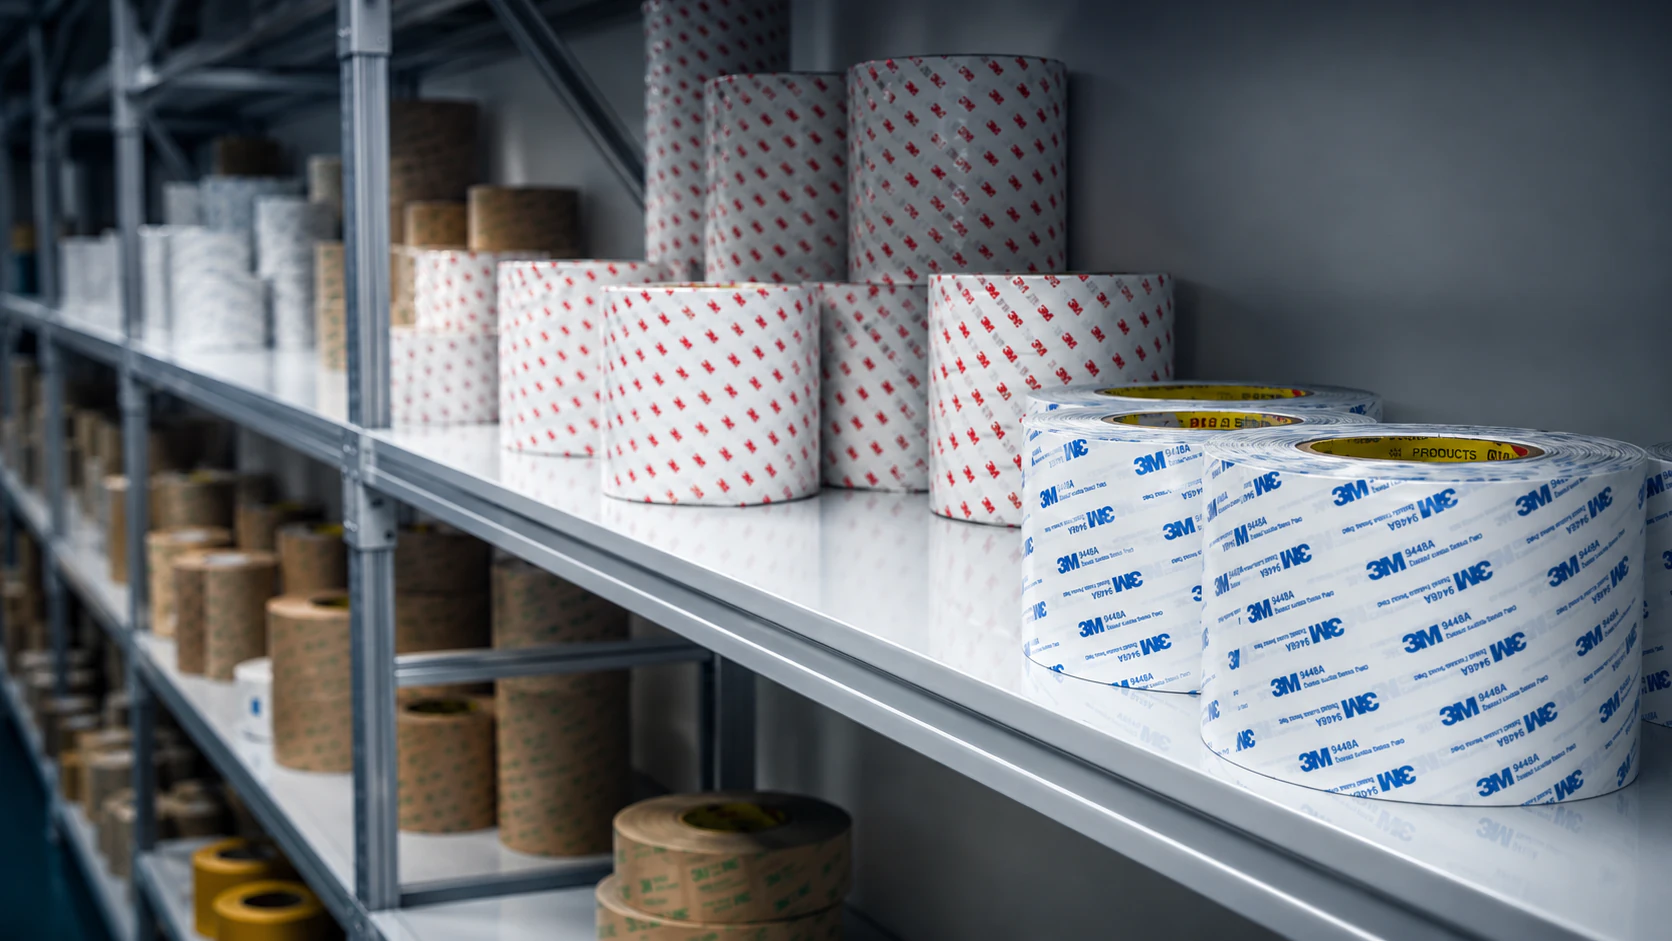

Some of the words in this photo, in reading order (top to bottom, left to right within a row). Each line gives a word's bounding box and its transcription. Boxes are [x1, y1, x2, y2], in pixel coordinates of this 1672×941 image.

[985, 282, 1000, 299] 3M
[980, 316, 995, 333] 3M
[1037, 304, 1054, 321] 3M
[1002, 345, 1018, 363] 3M
[1031, 339, 1047, 356] 3M
[1062, 332, 1077, 349] 3M
[976, 351, 991, 368] 3M
[991, 421, 1005, 440] 3M
[1133, 451, 1166, 477] 3M
[1412, 447, 1477, 461] PRODUCTS
[1039, 485, 1059, 509] 3M
[1252, 471, 1283, 497] 3M
[1332, 479, 1369, 507] 3M
[1416, 486, 1459, 520] 3M
[1516, 483, 1553, 517] 3M
[1587, 486, 1614, 519] 3M
[1085, 505, 1116, 529] 3M
[1162, 516, 1197, 541] 3M
[1056, 552, 1081, 575] 3M
[1279, 543, 1313, 570] 3M
[1366, 551, 1407, 581] 3M
[1404, 539, 1436, 557] 9448A
[1111, 570, 1144, 594] 3M
[1452, 560, 1494, 593] 3M
[1547, 555, 1581, 588] 3M
[1247, 598, 1273, 624] 3M
[1077, 616, 1106, 638] 3M
[1308, 617, 1345, 645] 3M
[1402, 623, 1444, 654] 3M
[1441, 611, 1472, 631] 9448A
[1575, 624, 1604, 657] 3M
[1138, 632, 1173, 657] 3M
[1490, 631, 1528, 663] 3M
[1270, 672, 1302, 698] 3M
[1299, 664, 1326, 680] 9448A
[1341, 691, 1380, 720] 3M
[1439, 695, 1480, 727] 3M
[1477, 682, 1508, 703] 9448A
[1522, 701, 1559, 734] 3M
[1599, 690, 1620, 724] 3M
[1298, 747, 1334, 773] 3M
[1330, 739, 1360, 755] 9448A
[1376, 764, 1417, 793] 3M
[1476, 766, 1515, 798] 3M
[1512, 752, 1541, 773] 9448A
[1553, 768, 1585, 802] 3M
